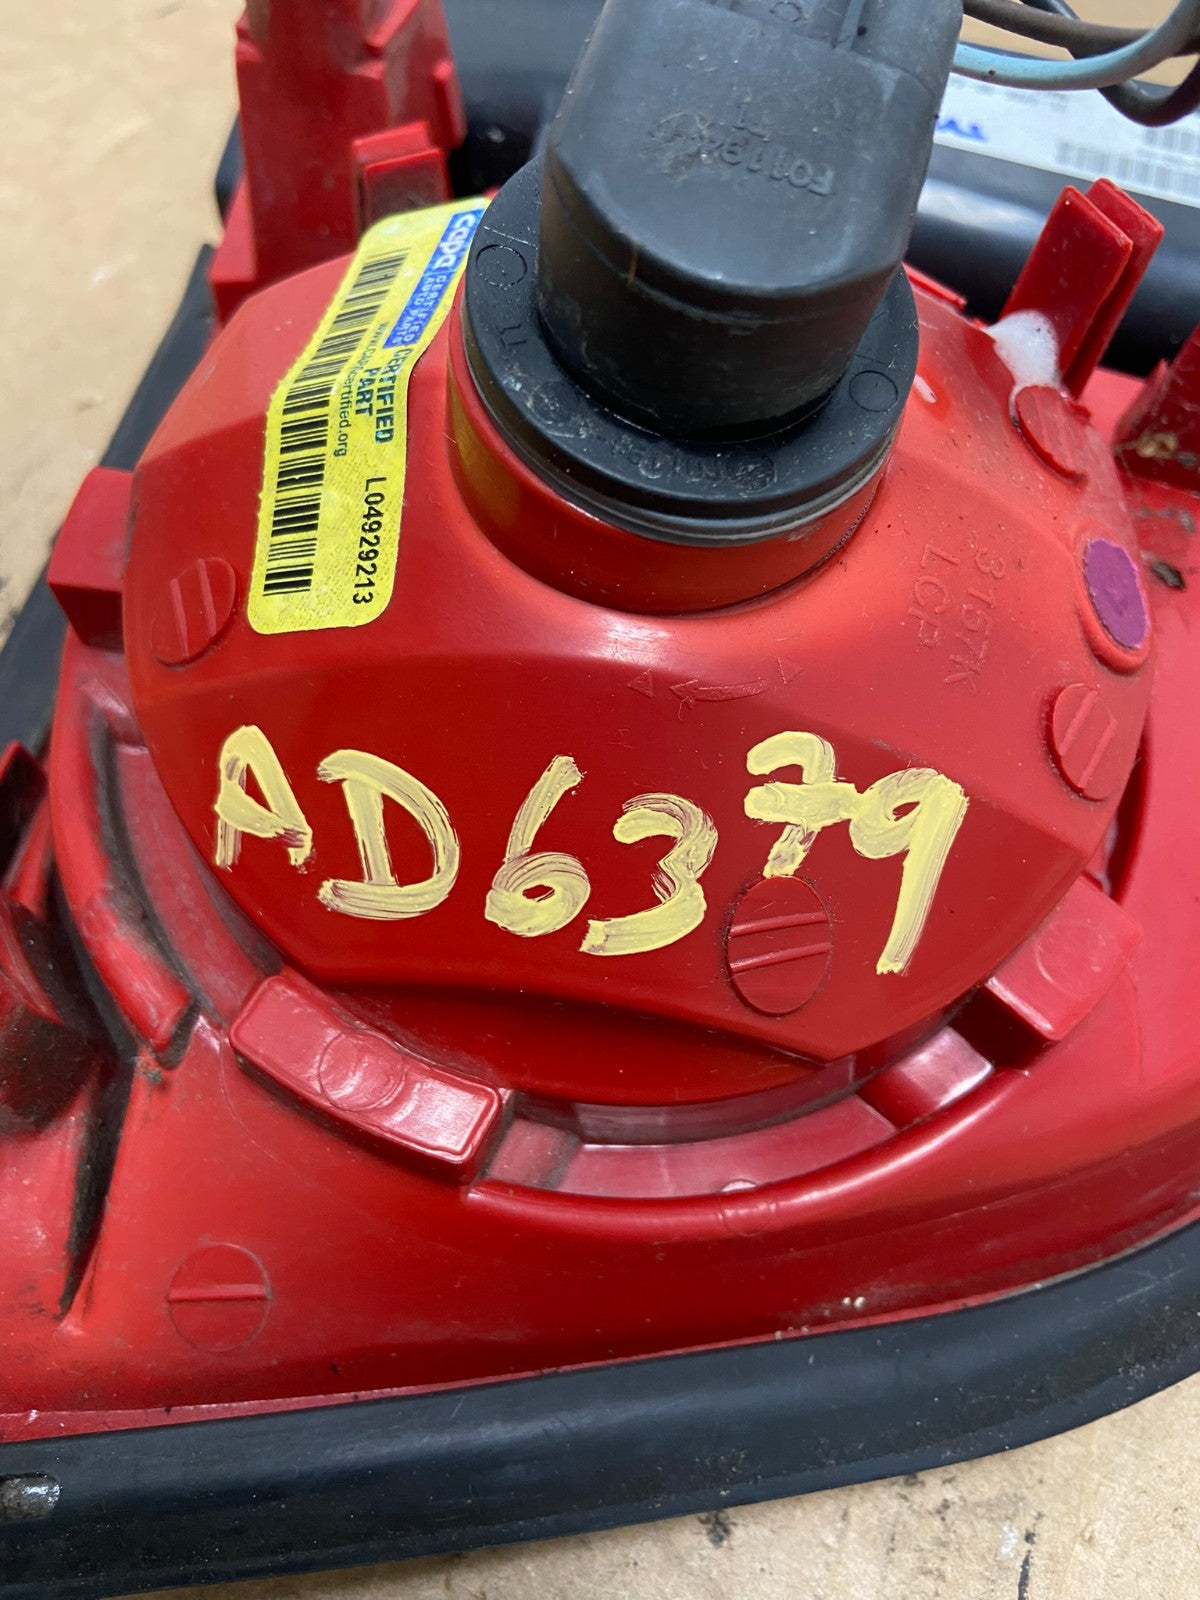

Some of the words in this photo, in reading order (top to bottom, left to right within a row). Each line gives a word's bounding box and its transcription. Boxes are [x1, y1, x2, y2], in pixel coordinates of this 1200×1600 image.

[403, 274, 447, 342] CERTIFIED
[355, 367, 381, 416] PART
[375, 348, 414, 443] CERTIFIED
[352, 476, 388, 605] L04929213
